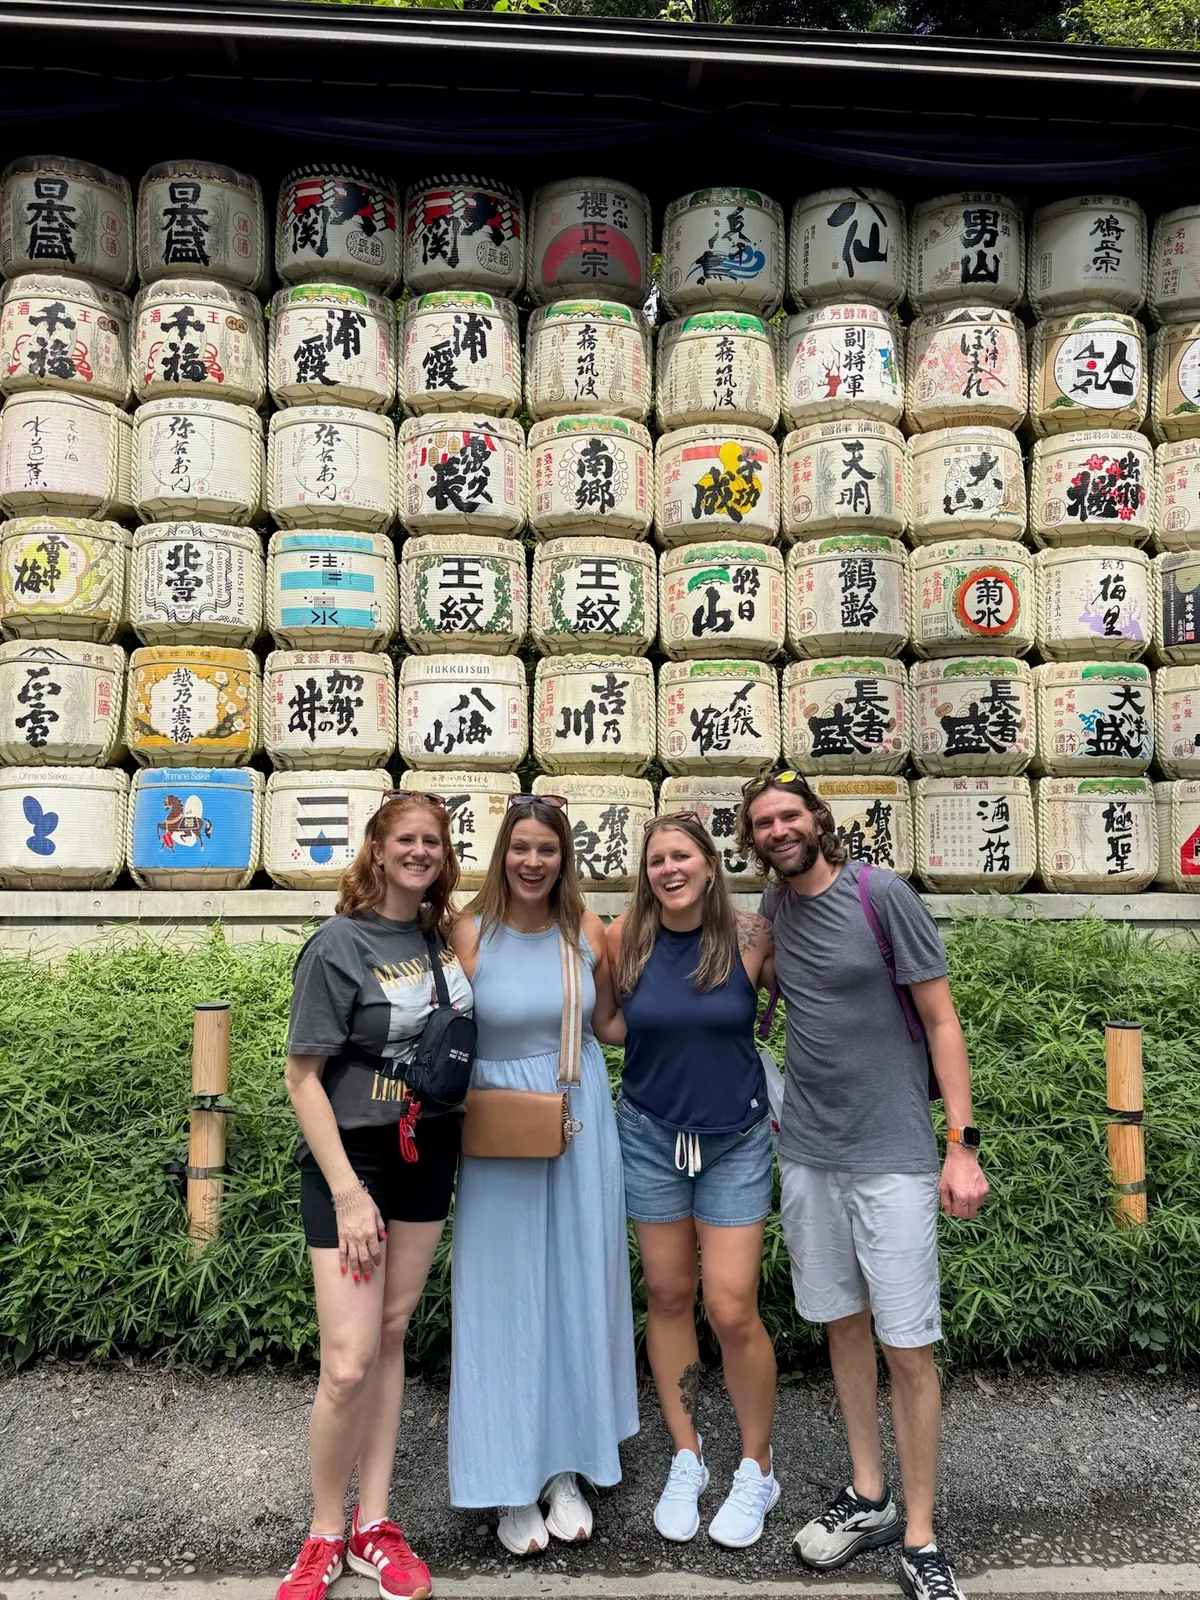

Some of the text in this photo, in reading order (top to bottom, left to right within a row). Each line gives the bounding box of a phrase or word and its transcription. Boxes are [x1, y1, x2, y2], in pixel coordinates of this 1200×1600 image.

[26, 178, 78, 264] 日本盛
[161, 182, 211, 266] 日本盛
[577, 191, 609, 278] 櫻正宗
[961, 209, 1000, 284] 男山
[1089, 215, 1125, 273] 鳩正宗
[28, 301, 76, 379] 千福
[160, 305, 208, 383] 千福
[293, 309, 367, 387] 浦霞
[422, 312, 492, 392] 浦霞
[574, 323, 600, 402] 霧筑波
[712, 336, 738, 412] 霧筑波
[842, 327, 867, 398] 副将軍
[834, 439, 878, 515] 天明
[14, 535, 69, 595] 雪中梅
[165, 542, 204, 603] 北雪
[237, 550, 245, 616] HOKUSETSU
[437, 557, 484, 632] 王紋
[575, 559, 620, 632] 王紋
[838, 558, 878, 627] 鶴齢
[973, 578, 1007, 628] 菊水
[170, 667, 194, 744] 越乃寒梅
[424, 687, 496, 754] 八海山
[556, 672, 630, 745] 吉乃川
[807, 679, 890, 757] 長者盛
[940, 679, 1022, 757] 長者盛
[1066, 732, 1077, 753] 大洋
[1084, 685, 1148, 758] 大洋盛
[47, 771, 68, 780] Sake
[191, 771, 211, 780] Sake
[976, 796, 1011, 873] 酒一筋
[1102, 801, 1135, 875] 極聖
